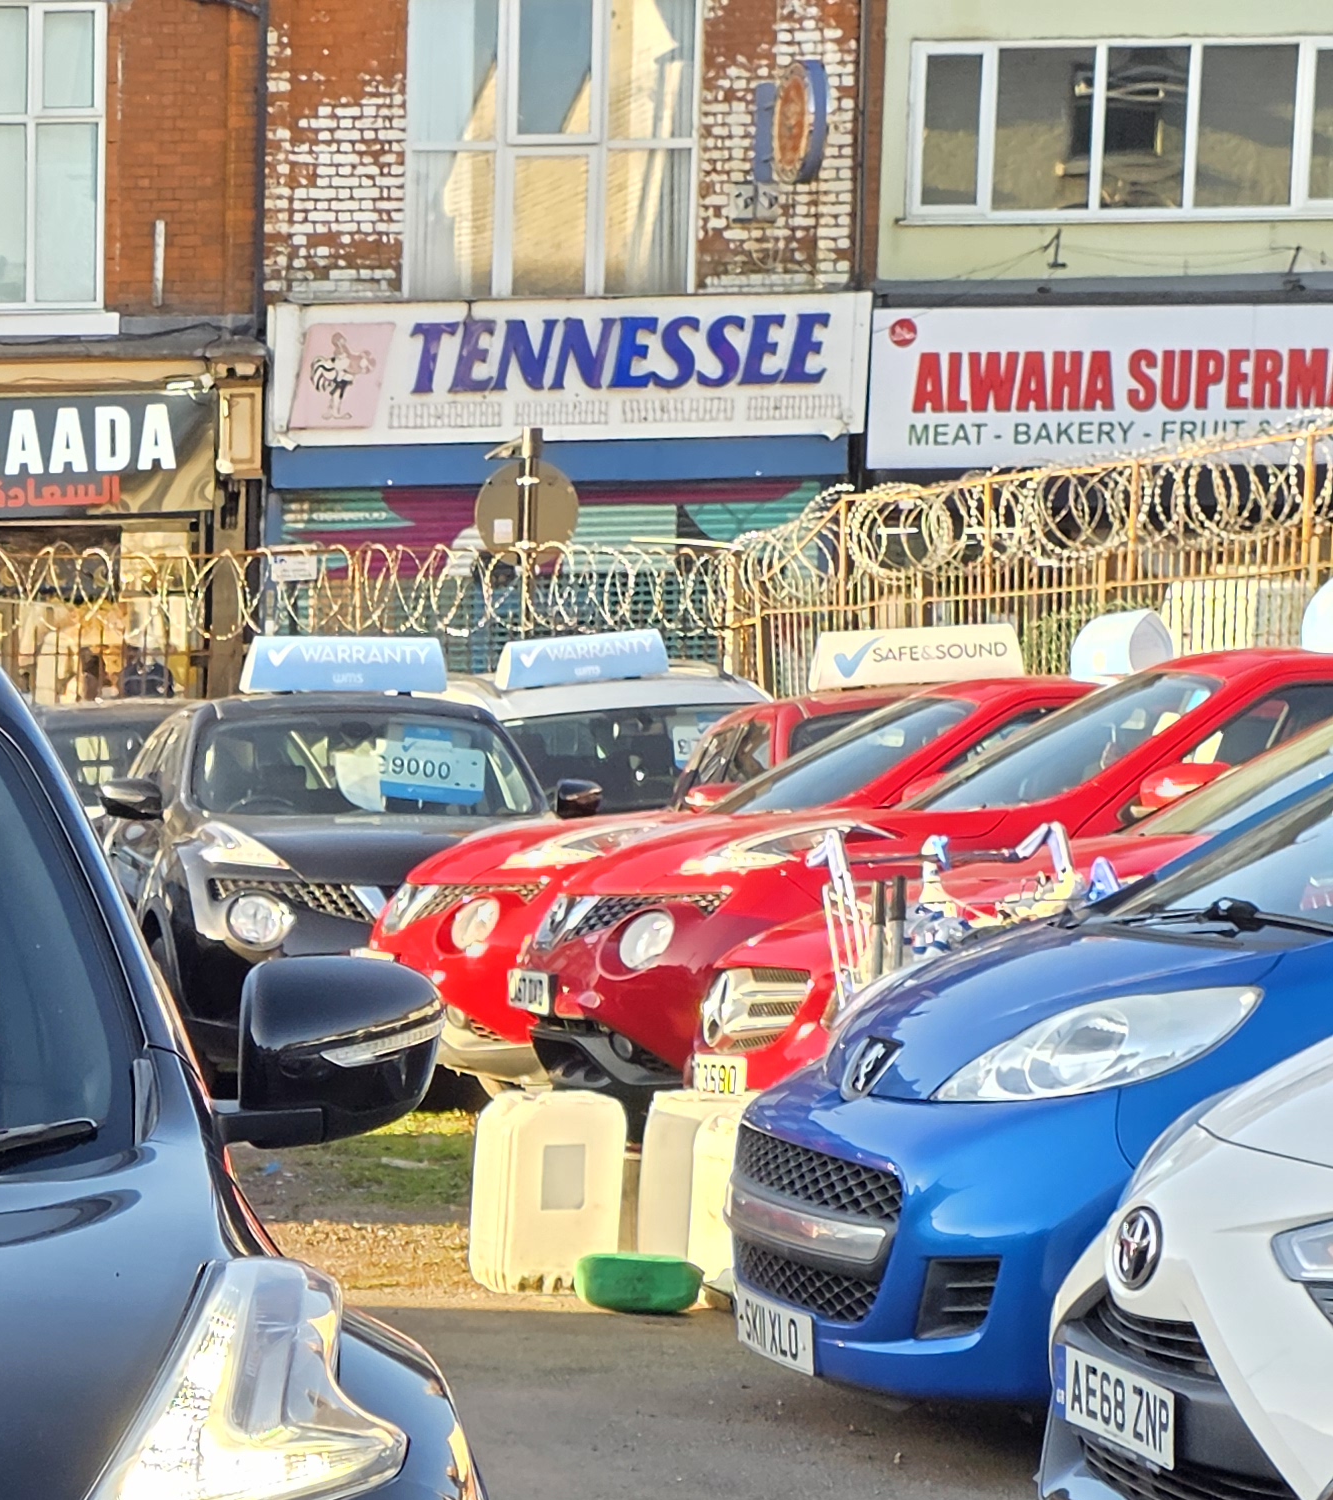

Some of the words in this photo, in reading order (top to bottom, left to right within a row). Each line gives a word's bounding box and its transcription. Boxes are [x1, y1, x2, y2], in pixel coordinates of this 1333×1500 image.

[409, 312, 831, 394] TENNESSEE
[911, 350, 1115, 414] ALWAHA
[1126, 348, 1333, 411] SUPERM
[907, 423, 988, 447] MEAT
[1013, 420, 1136, 445] BAKERY
[300, 643, 427, 665] WARRANTY
[545, 636, 654, 662] WARRANTY
[872, 640, 1008, 664] SAFE&SOUND
[333, 673, 364, 684] wms
[1071, 1359, 1126, 1433] AE68
[1132, 1384, 1170, 1454] ZNP
